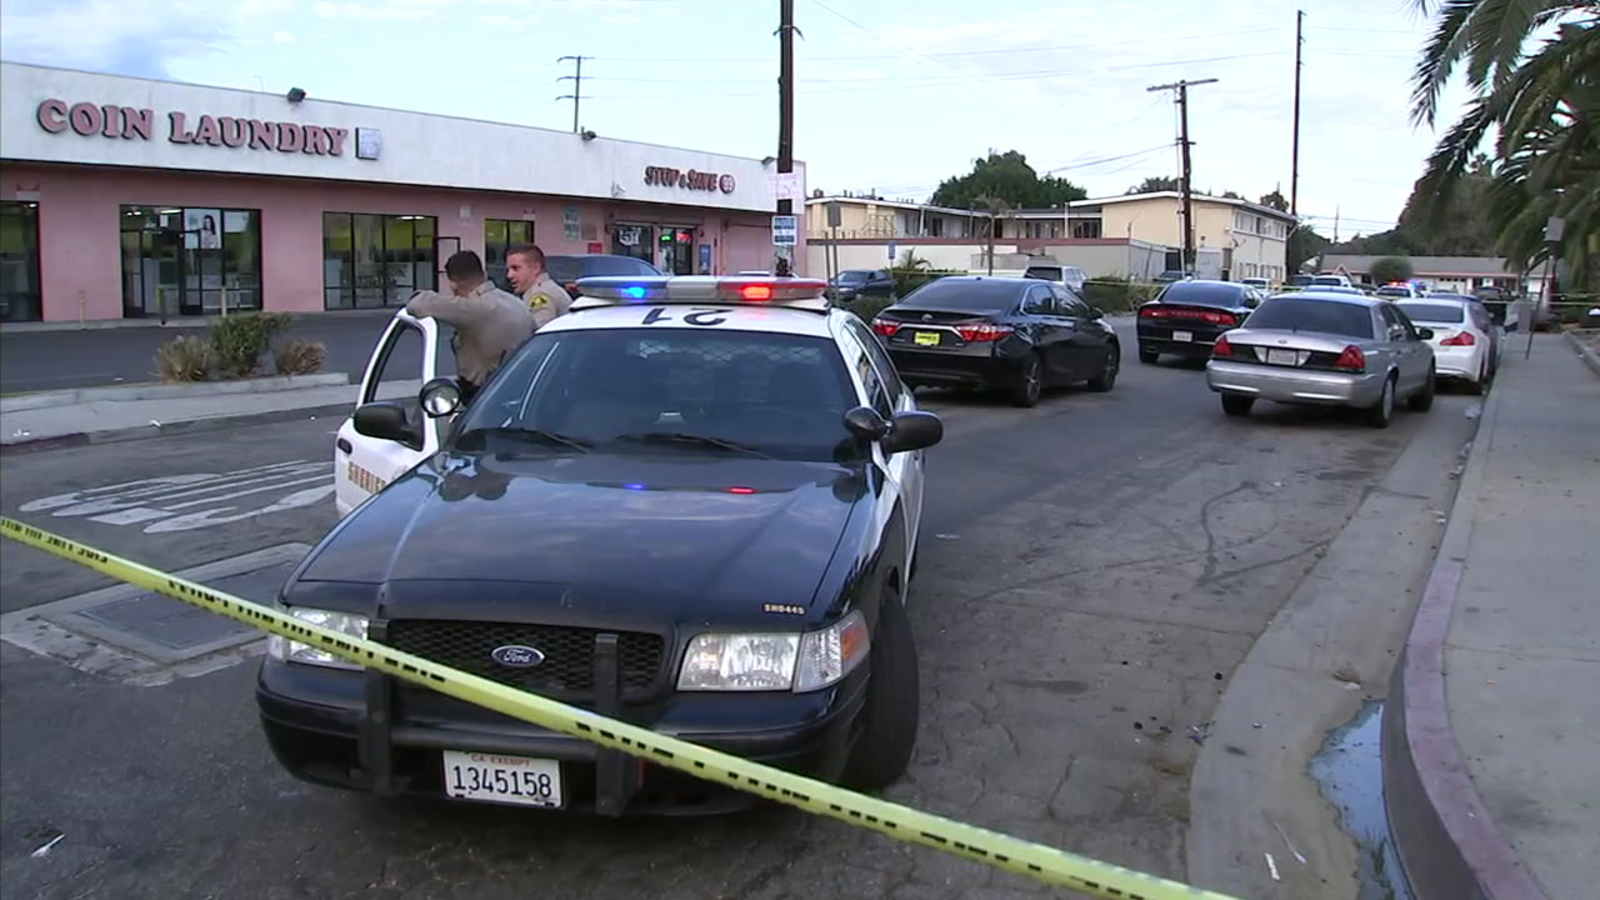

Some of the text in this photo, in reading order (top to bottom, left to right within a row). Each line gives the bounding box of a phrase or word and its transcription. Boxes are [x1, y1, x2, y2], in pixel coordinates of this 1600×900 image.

[37, 98, 154, 140] COIN
[168, 111, 349, 157] LAUNDRY
[504, 648, 533, 663] Ford
[490, 756, 531, 767] EXEMPT
[453, 765, 552, 798] 1345158
